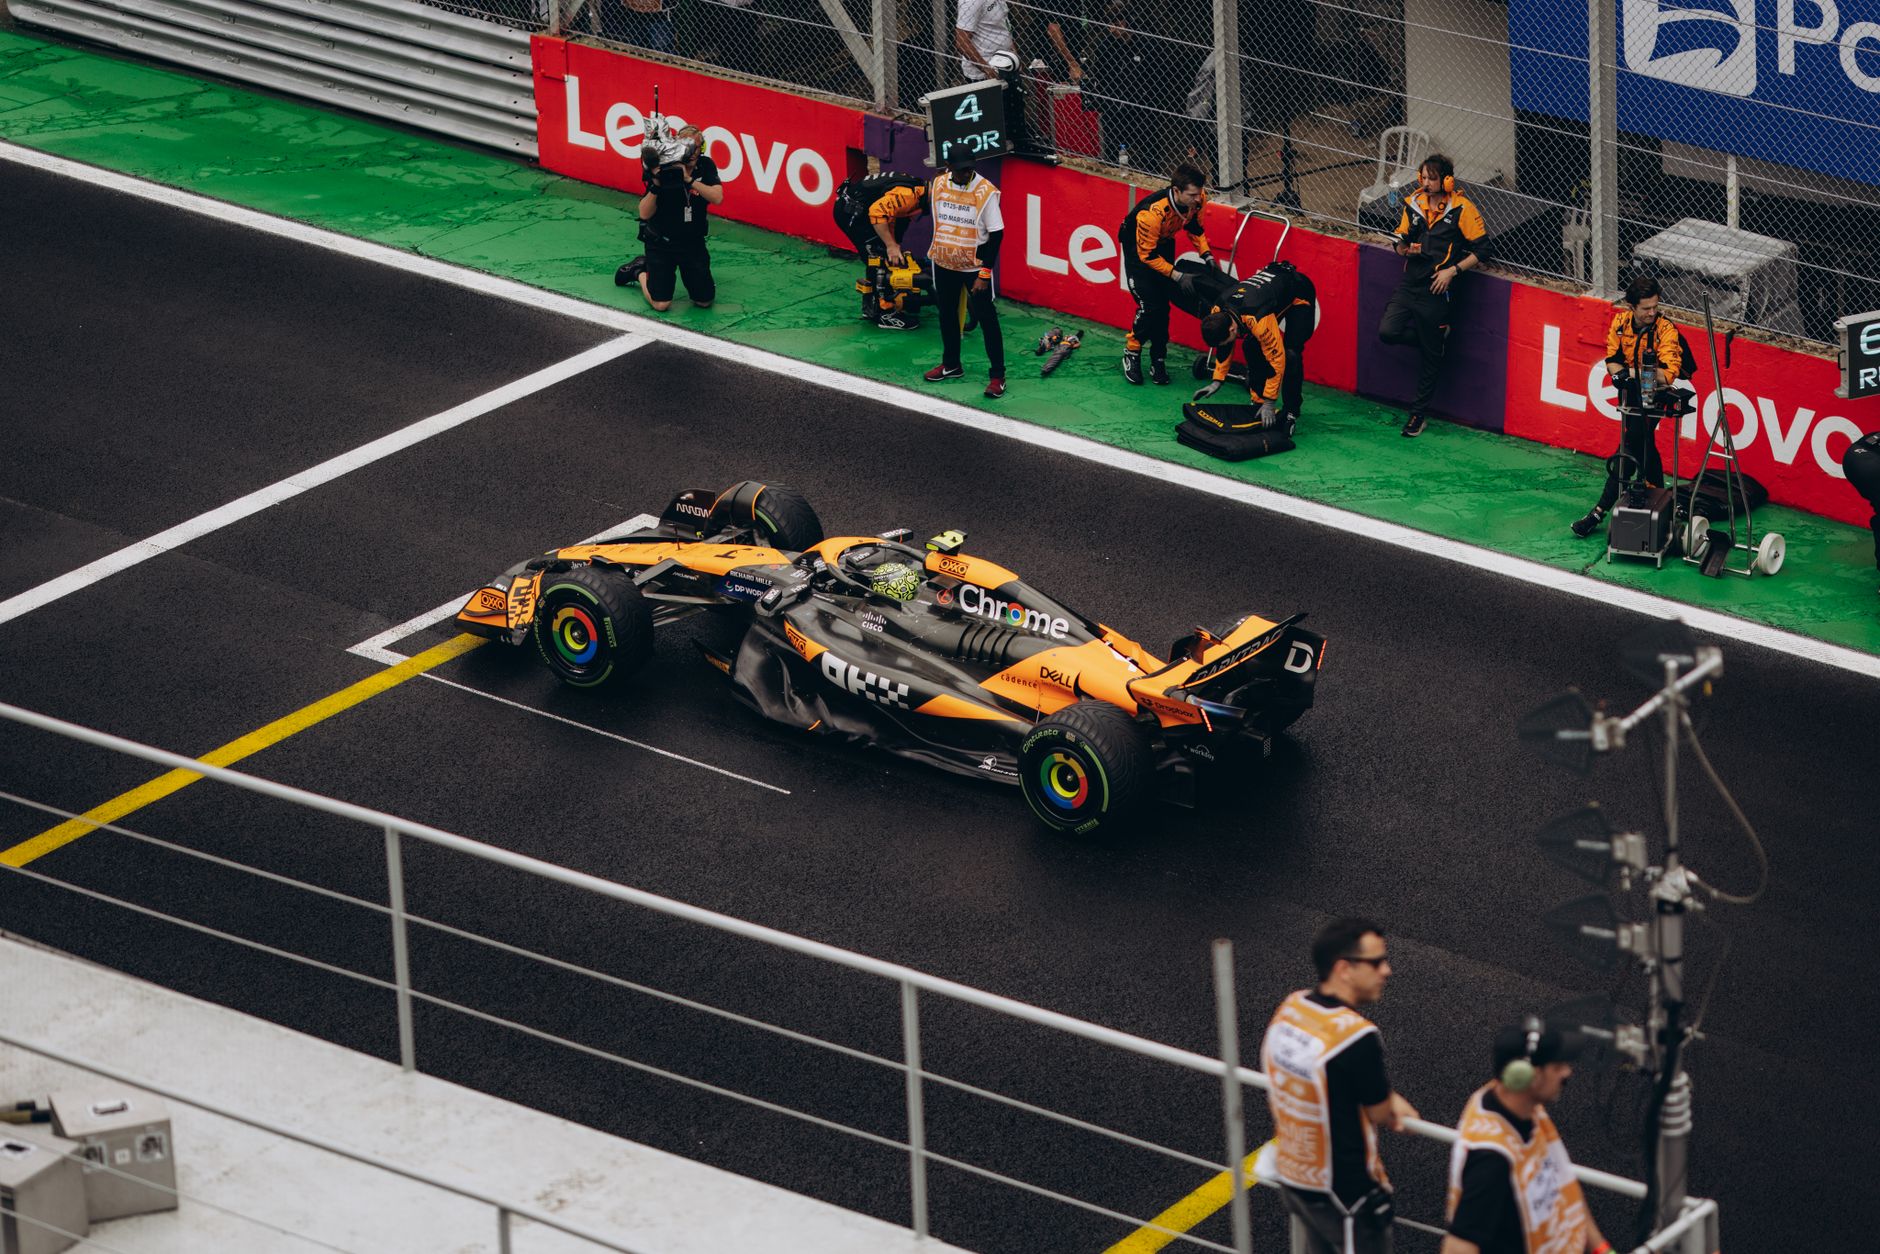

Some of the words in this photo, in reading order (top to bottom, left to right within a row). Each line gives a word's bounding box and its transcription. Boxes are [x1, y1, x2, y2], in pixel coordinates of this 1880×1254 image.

[955, 94, 983, 122] 4
[948, 215, 976, 225] MARSHAL
[1859, 367, 1880, 389] R
[729, 570, 755, 582] RICHARD
[755, 577, 773, 587] MILLE
[939, 558, 969, 578] OXXO
[734, 584, 746, 593] DP
[745, 586, 764, 597] WOR
[480, 593, 506, 611] OXXO
[959, 583, 1069, 639] Chrome
[1283, 640, 1314, 674] D
[1040, 666, 1072, 688] DELL
